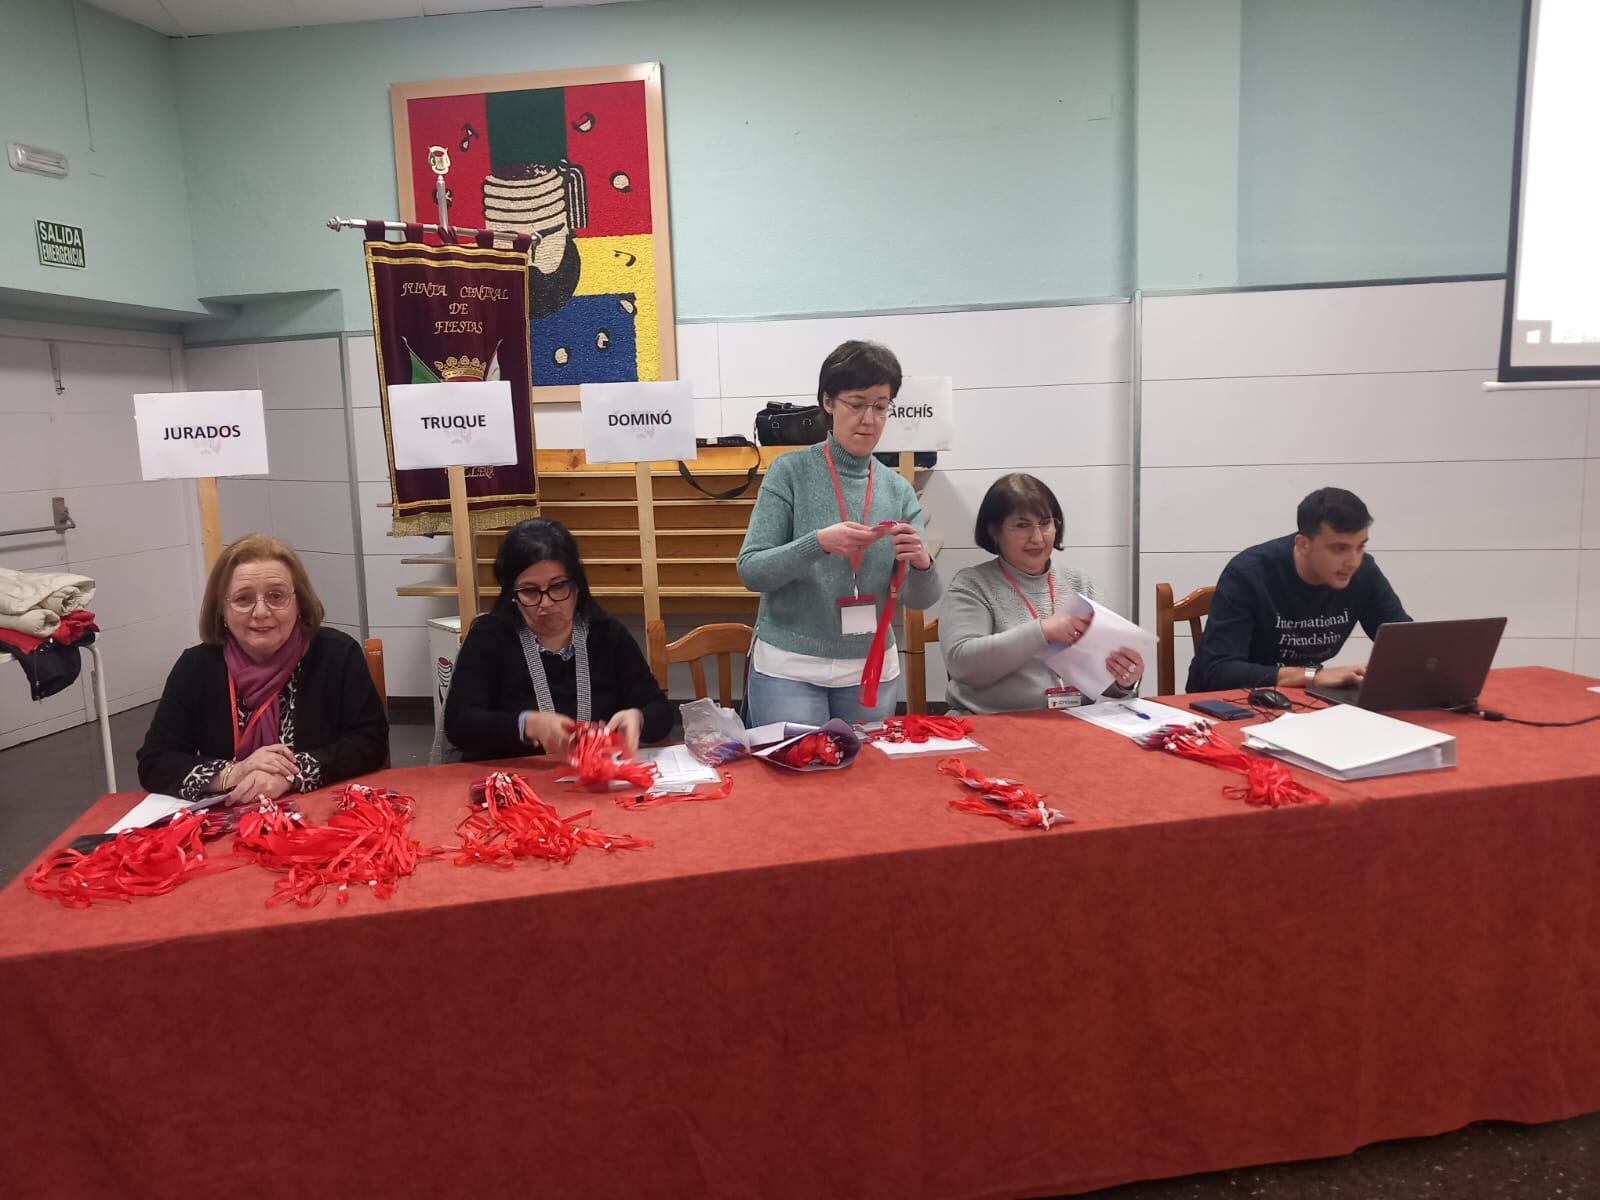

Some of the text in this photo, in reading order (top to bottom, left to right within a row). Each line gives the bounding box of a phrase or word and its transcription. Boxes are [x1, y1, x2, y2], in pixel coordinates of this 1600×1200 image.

[39, 222, 82, 247] SALIDA
[42, 242, 84, 266] EMERGENCIA
[400, 282, 509, 301] JUNTA CENTRAL
[448, 302, 469, 315] DE
[434, 320, 483, 335] FIESTAS
[608, 410, 672, 426] DOMINÓ
[888, 403, 933, 418] ARCHÍS
[420, 414, 487, 430] TRUQUE
[163, 424, 241, 441] JURADOS
[1275, 608, 1349, 629] Inernational
